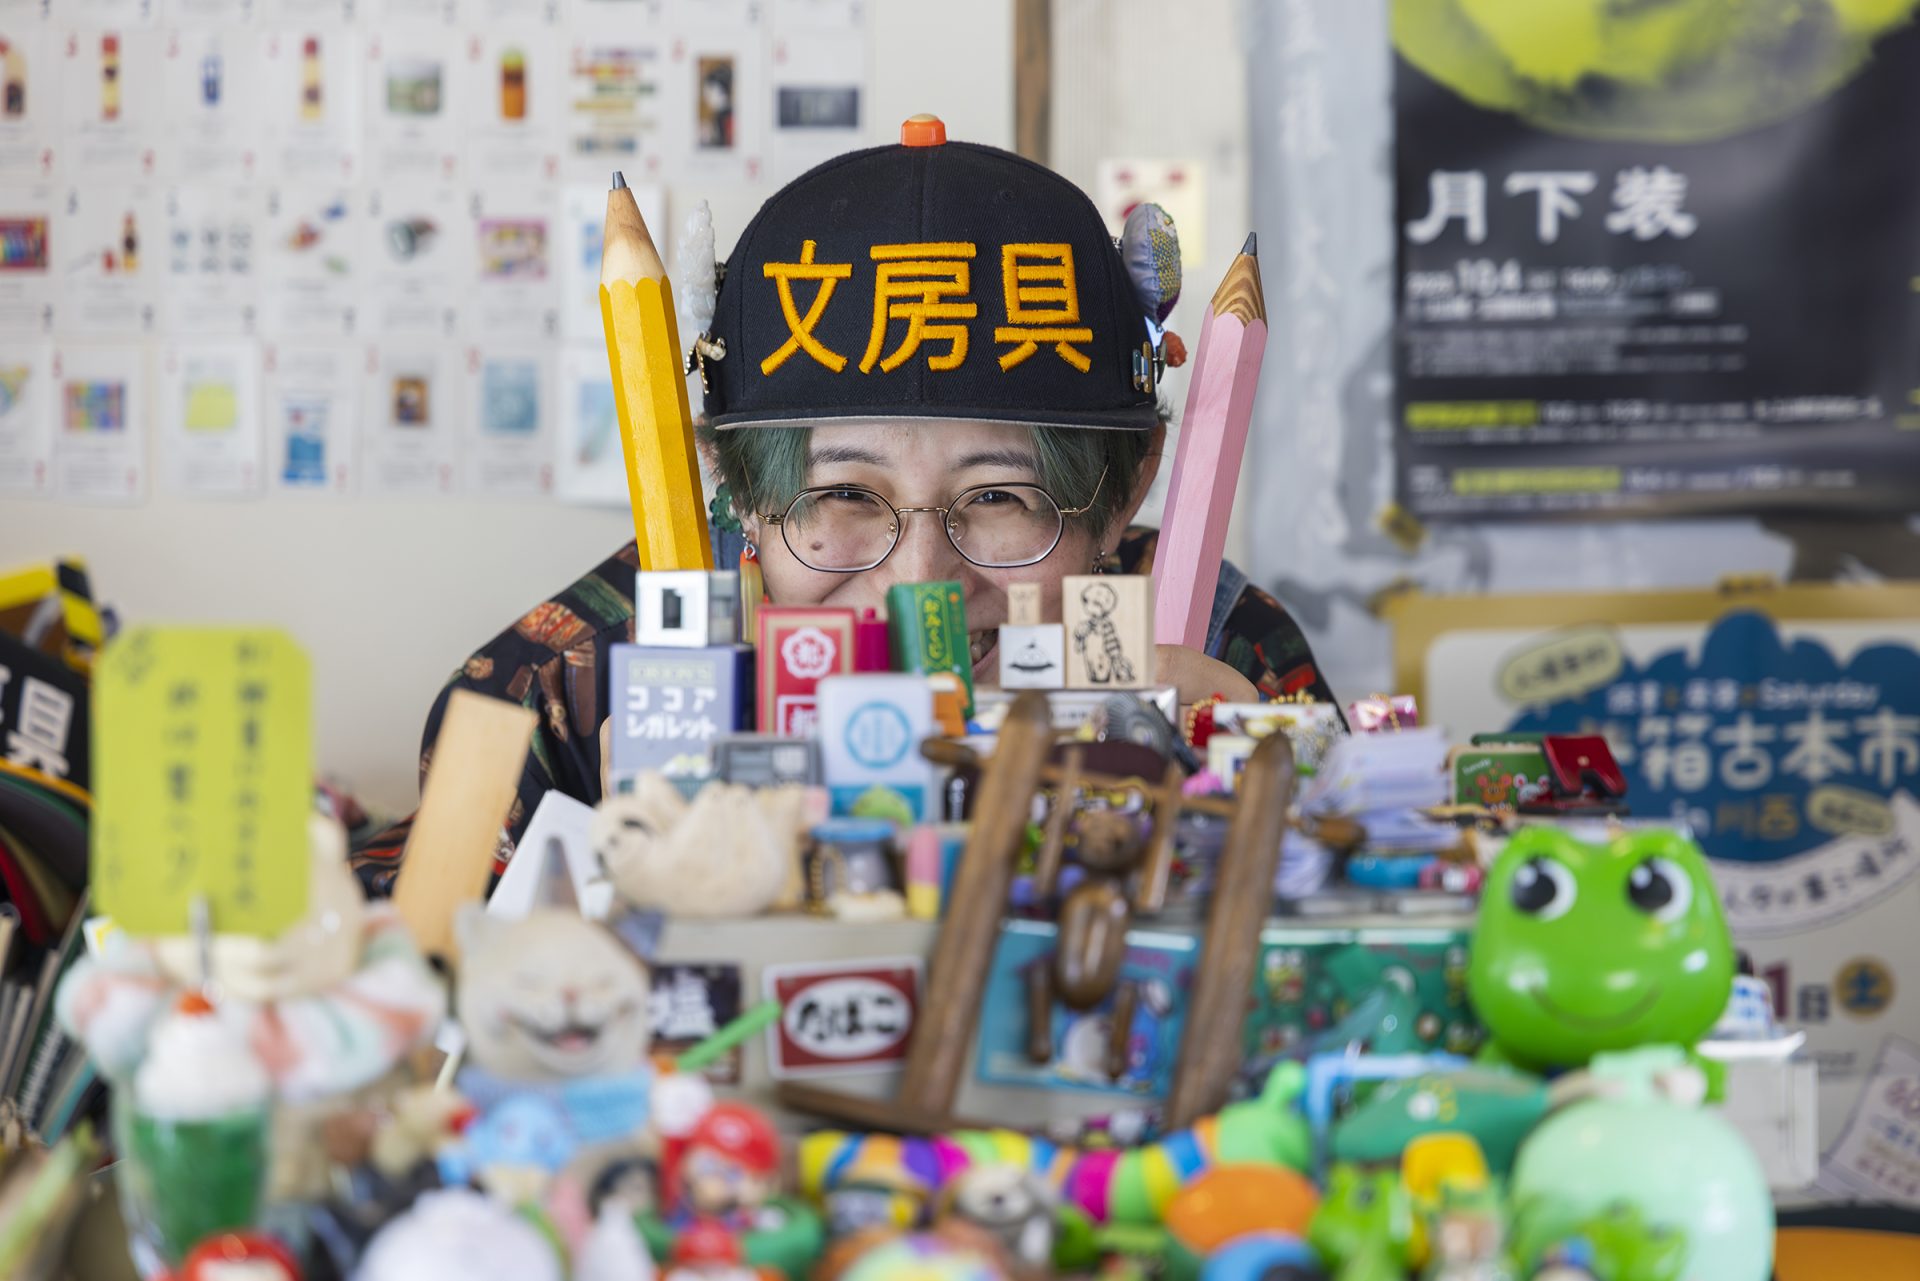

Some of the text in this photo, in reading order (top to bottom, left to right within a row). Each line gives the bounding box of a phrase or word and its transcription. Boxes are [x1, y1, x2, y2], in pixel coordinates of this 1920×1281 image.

[761, 240, 1094, 377] 文房具
[0, 663, 74, 778] 具
[627, 686, 716, 713] ココア
[627, 713, 717, 741] シガレット
